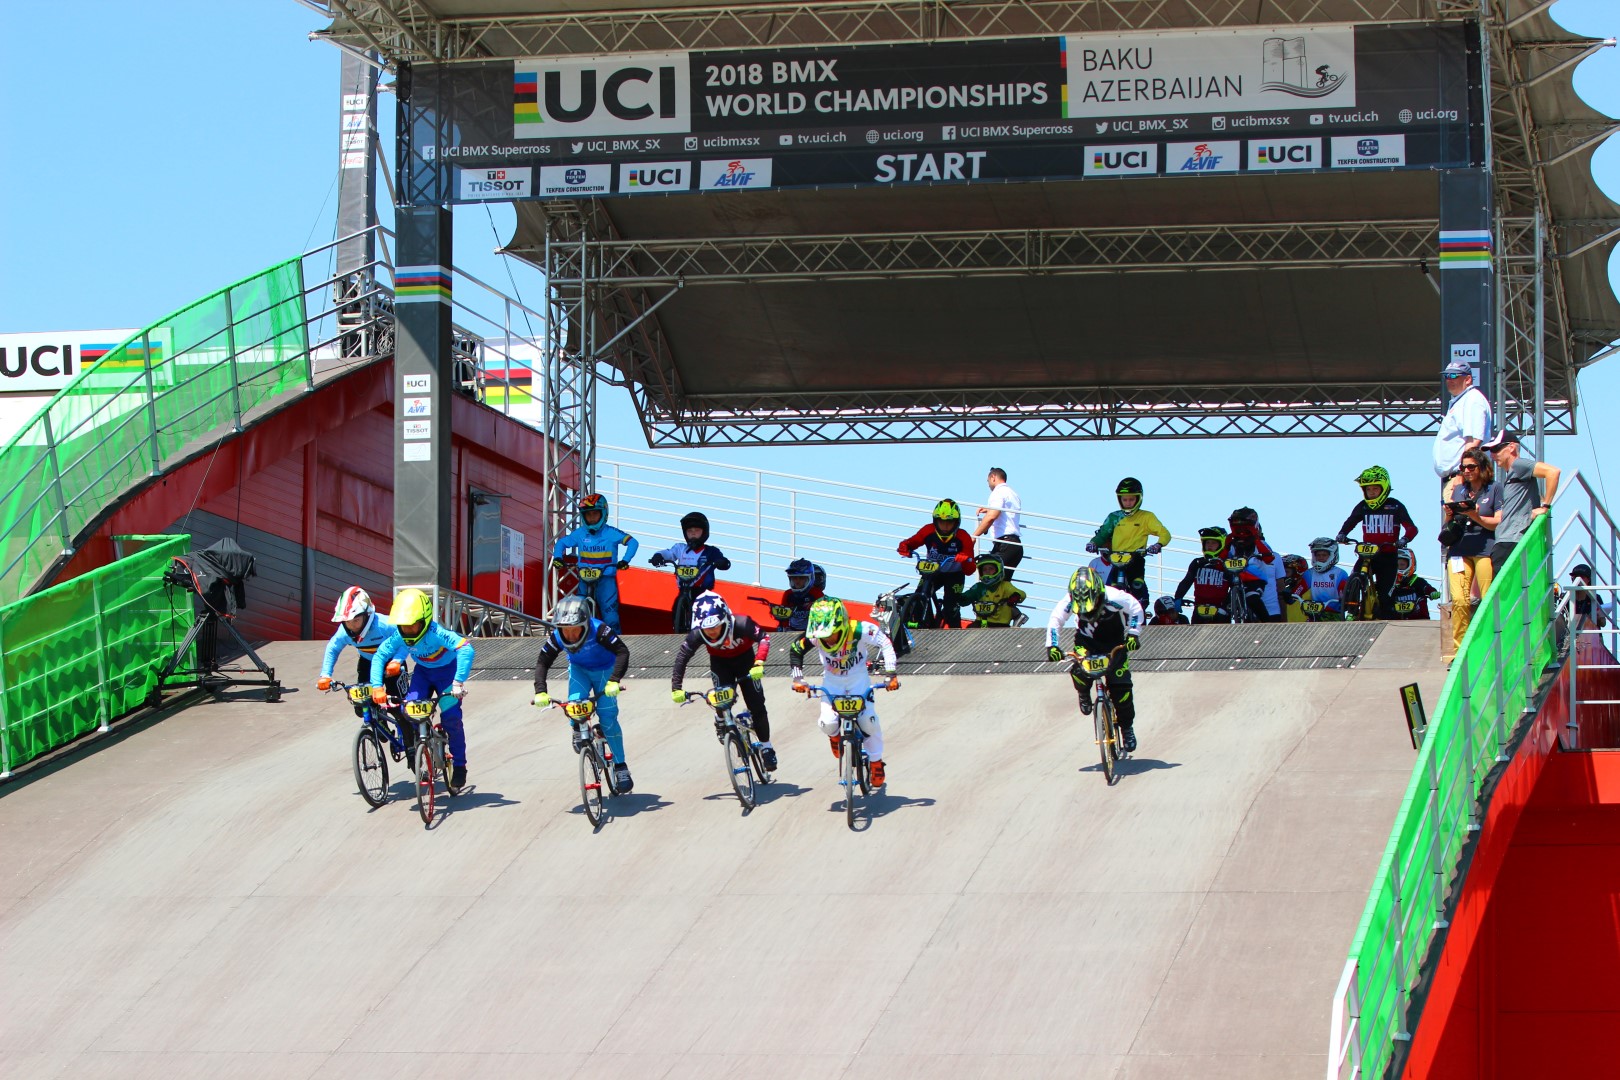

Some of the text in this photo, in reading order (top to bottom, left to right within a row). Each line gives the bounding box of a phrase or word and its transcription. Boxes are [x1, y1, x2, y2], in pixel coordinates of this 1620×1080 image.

[1083, 48, 1152, 71] BAKU
[706, 60, 838, 86] 2018 BMX
[544, 66, 675, 123] UCI
[1083, 75, 1242, 102] AZERBAIJAN
[706, 82, 1048, 117] WORLD CHAMPIONSHIPS
[1231, 114, 1290, 128] ucibmxsx
[1328, 111, 1379, 123] tv.uci.ch
[1416, 108, 1458, 122] uci.org
[960, 124, 1073, 138] UCI BMX Supercross
[1113, 119, 1188, 134] UCI_BMX_SX
[703, 136, 760, 148] ucibmxsx
[798, 132, 846, 144] tv.uci.ch
[883, 129, 924, 142] uci.org
[441, 143, 551, 158] UCI BMX Supercross
[587, 139, 660, 154] UCI_BMX_SX
[1104, 151, 1147, 169] UCI
[1268, 145, 1312, 164] UCI
[874, 151, 987, 182] START
[638, 168, 681, 186] UCI
[468, 180, 524, 192] TISSOT
[0, 345, 73, 378] UCI
[1365, 515, 1394, 533] LATVIA
[1196, 568, 1224, 585] LATVIA
[1088, 660, 1104, 669] 164
[354, 687, 370, 697] 130
[714, 691, 729, 702] 160
[412, 704, 427, 714] 134
[571, 704, 588, 714] 136
[840, 700, 857, 711] 132
